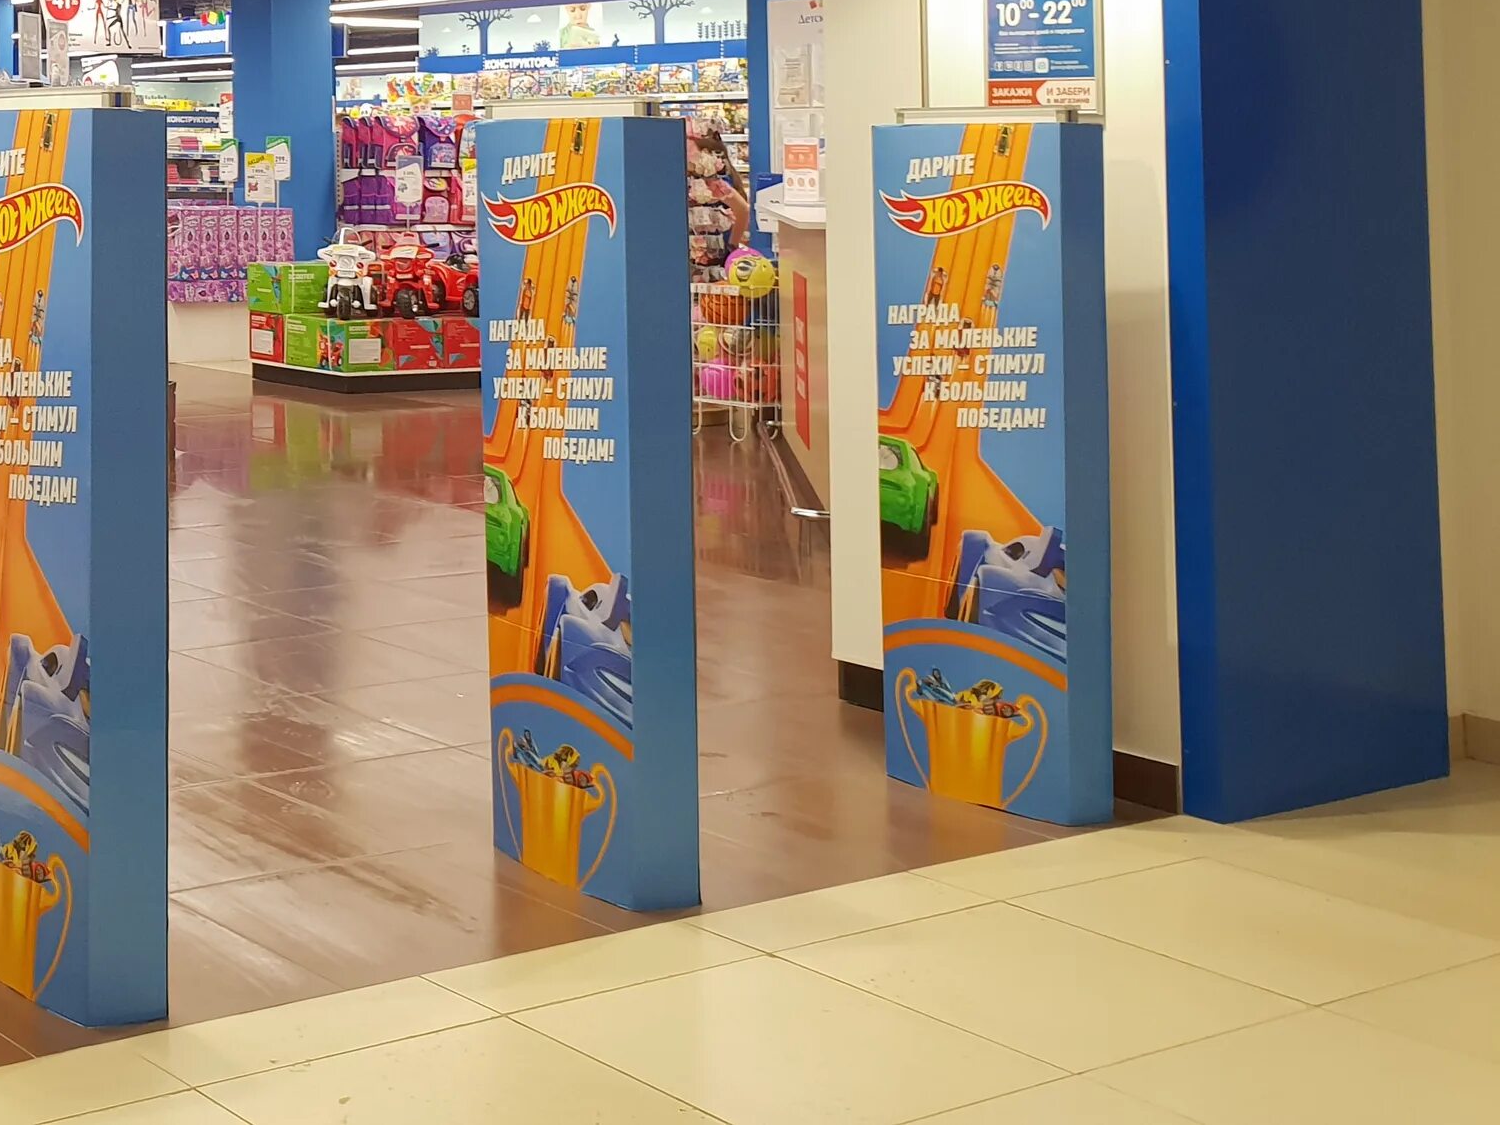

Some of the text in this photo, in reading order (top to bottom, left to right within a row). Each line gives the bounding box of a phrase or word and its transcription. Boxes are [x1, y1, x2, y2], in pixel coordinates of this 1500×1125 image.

[501, 151, 556, 185] ДАРИТЕ
[906, 153, 976, 184] ДАРИТЕ
[909, 326, 1038, 349] ЗА МАЛЕНЬКИЕ
[506, 347, 607, 370] ЗА МАЛЕНЬКИЕ
[892, 356, 953, 375] УСПЕХИ
[974, 353, 1045, 375] СТИМУЛ
[493, 377, 540, 400] УСПЕХИ
[556, 377, 614, 400] СТИМУЛ
[923, 381, 1027, 401] К БОЛЬШИМ
[22, 405, 78, 433] СТИМУЛ
[517, 406, 599, 431] К БОЛЬШИМ
[956, 407, 1046, 431] ПОБЕДАМ!
[543, 437, 615, 464] ПОБЕДАМ!
[8, 473, 78, 506] ПОБЕДАМ!
